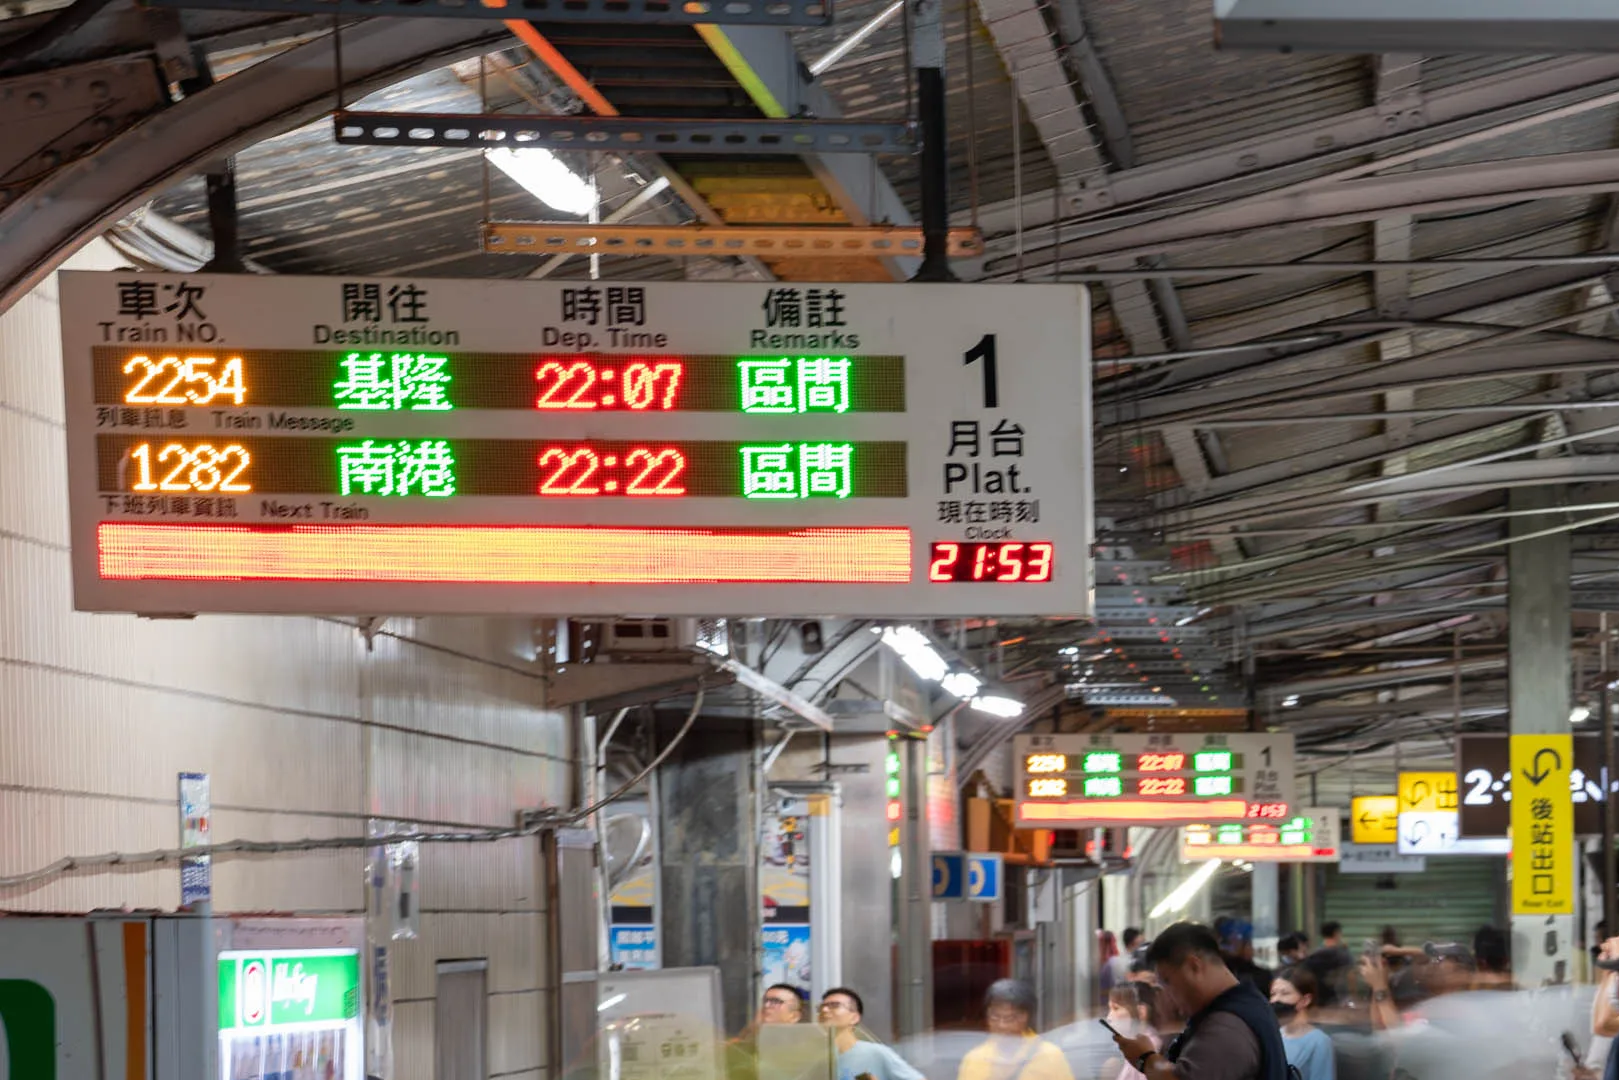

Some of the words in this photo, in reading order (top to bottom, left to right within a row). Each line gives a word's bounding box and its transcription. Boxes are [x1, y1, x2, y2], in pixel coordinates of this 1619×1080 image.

[117, 281, 206, 321] 車次
[342, 283, 428, 324] 開往
[561, 287, 646, 327] 時間
[763, 288, 847, 329] 備註
[98, 322, 168, 344] Train
[177, 323, 226, 345] NO.
[313, 324, 460, 347] Destination
[542, 329, 599, 350] Dep.
[607, 329, 668, 350] Time
[751, 330, 860, 350] Remarks
[123, 355, 247, 405] 2254
[334, 352, 453, 411] 基隆
[536, 361, 683, 410] 22:07
[738, 356, 852, 414] 區間
[963, 334, 998, 408] 1
[211, 410, 261, 431] Train
[267, 411, 354, 433] Message
[948, 420, 1025, 458] 月台
[131, 442, 252, 492] 1282
[336, 439, 456, 497] 南港
[538, 449, 687, 497] 22:22
[740, 443, 853, 499] 區間
[944, 463, 1031, 496] Plat.
[260, 499, 312, 518] Next
[317, 502, 369, 521] Train
[937, 500, 1040, 524] 現在時刻
[965, 525, 1012, 541] Clock
[930, 543, 1054, 581] 21:53
[1531, 797, 1554, 895] 後站出口
